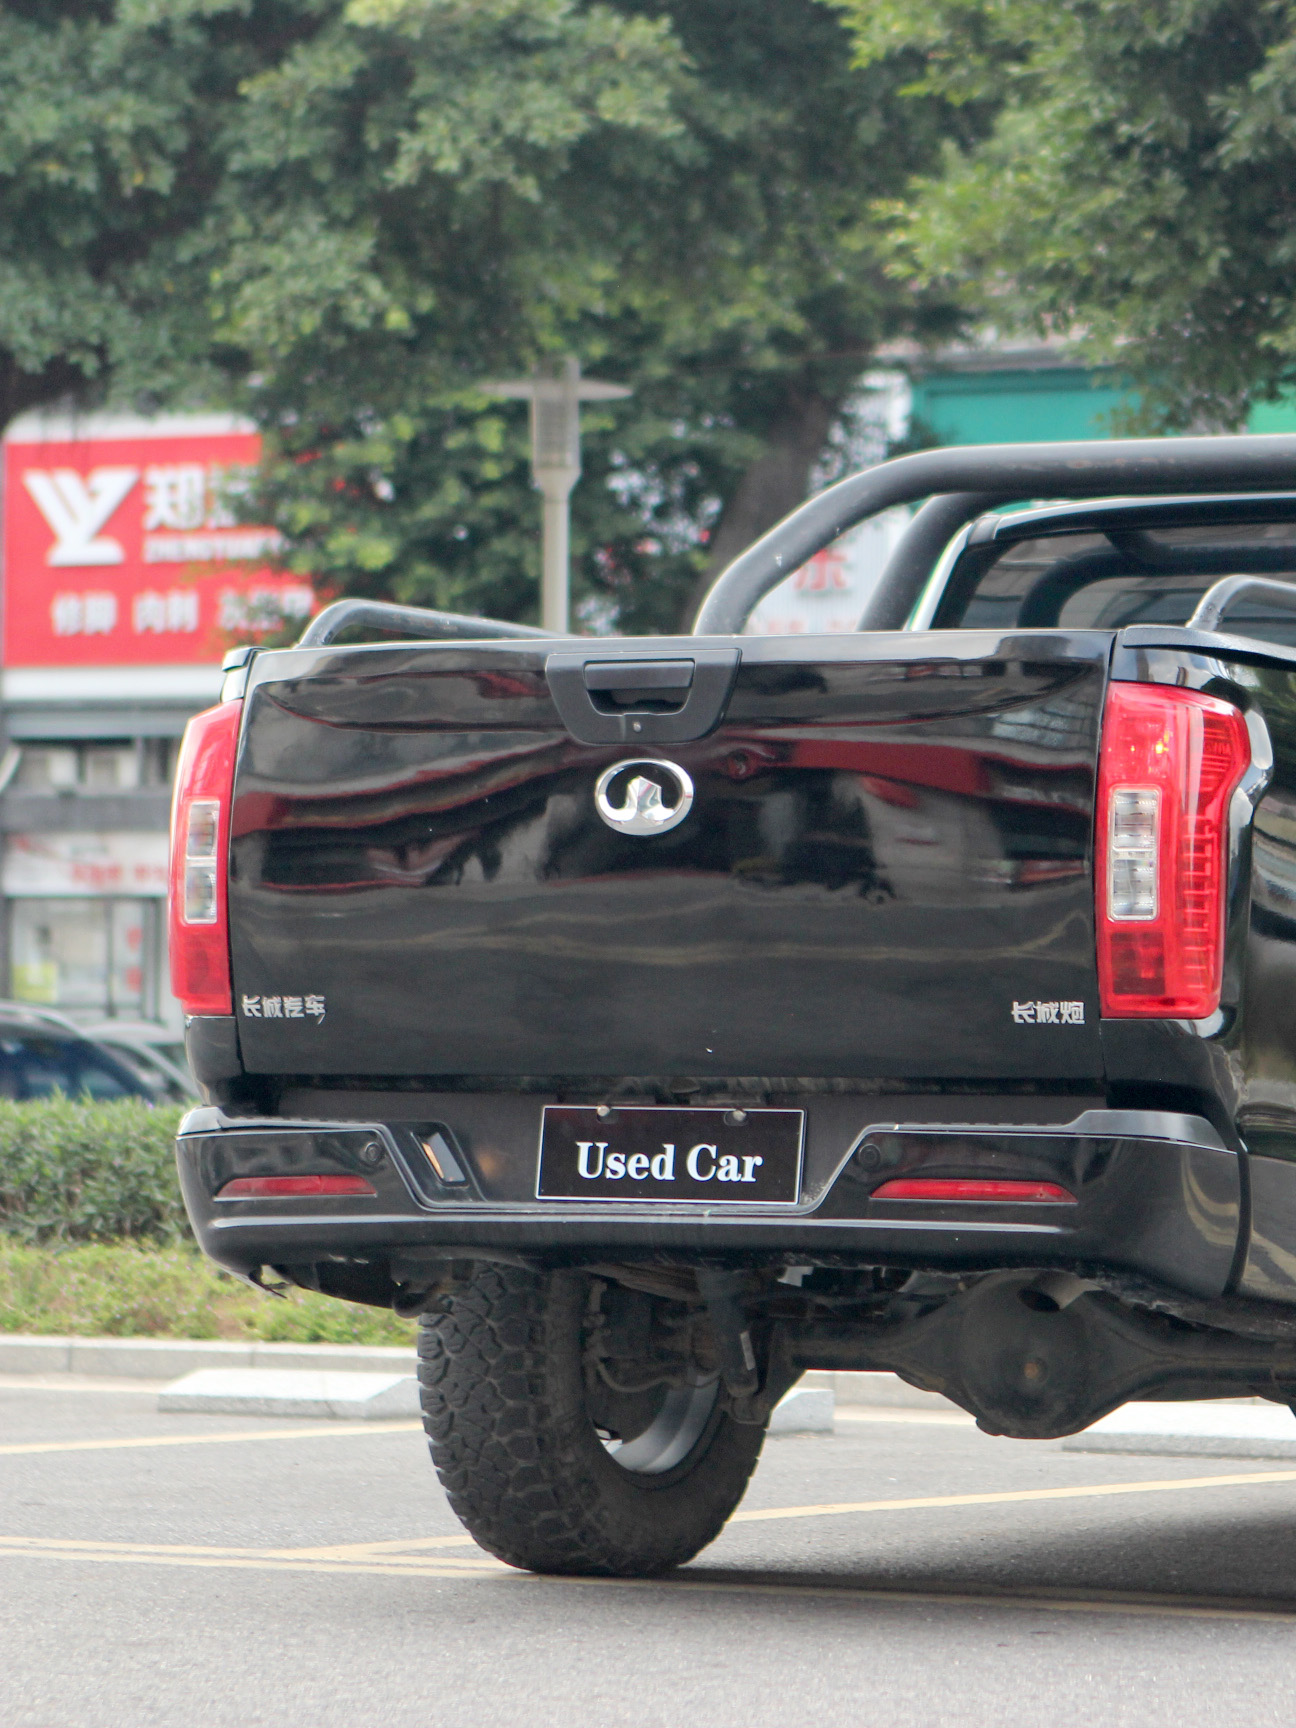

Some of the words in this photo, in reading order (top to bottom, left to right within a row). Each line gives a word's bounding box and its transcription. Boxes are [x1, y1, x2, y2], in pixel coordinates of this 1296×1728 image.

[242, 994, 327, 1020] 长城汽车
[1011, 1001, 1086, 1024] 长城炮
[575, 1141, 676, 1181] Used
[686, 1143, 763, 1182] Car
